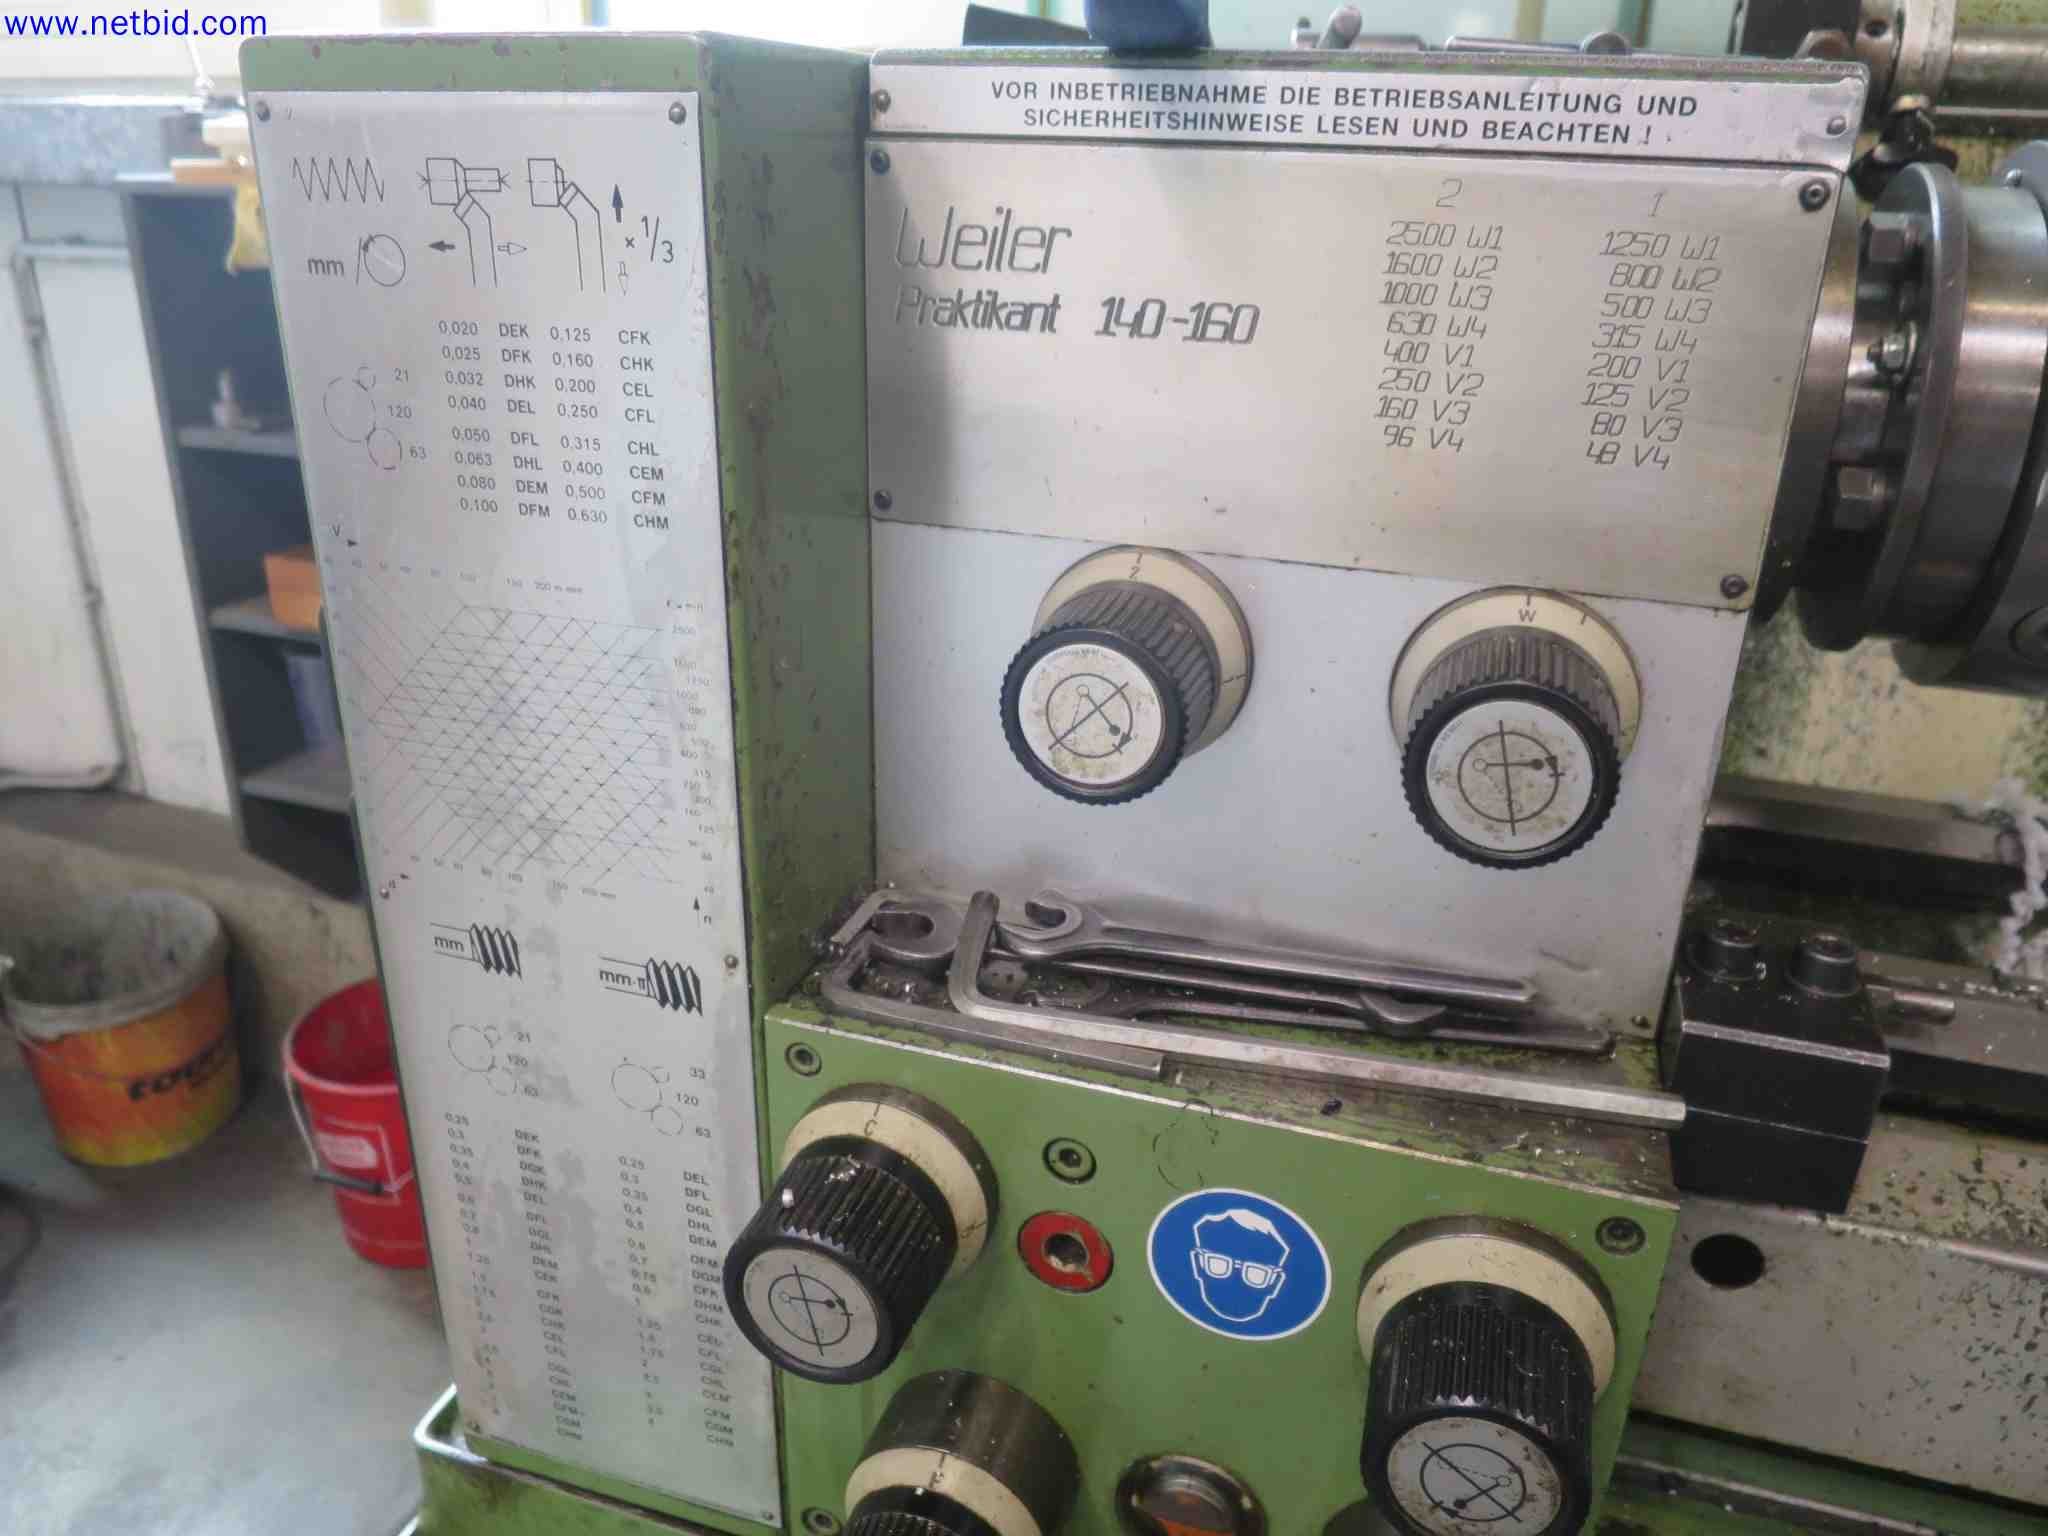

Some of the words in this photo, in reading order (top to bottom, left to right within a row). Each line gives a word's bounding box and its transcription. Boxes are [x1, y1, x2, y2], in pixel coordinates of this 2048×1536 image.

[991, 81, 1038, 99] VOR
[1050, 82, 1267, 104] INBETRIEBNAHME
[1280, 86, 1321, 105] DIE
[1334, 87, 1622, 113] BETRIEBSANLEITUNG
[1637, 95, 1698, 117] UND
[1023, 109, 1304, 133] SICHERHEITSHINWEISE
[1317, 116, 1399, 136] LESEN
[1412, 118, 1468, 138] UND
[1481, 120, 1630, 144] BEACHTEN
[1435, 178, 1464, 208] 2
[1648, 190, 1667, 218] 1
[895, 206, 1073, 274] Weiler
[1385, 221, 1457, 248] 2500
[1466, 223, 1504, 251] W1
[1599, 231, 1671, 258] 1250
[1679, 234, 1720, 261] W1
[307, 257, 345, 278] mm
[1381, 251, 1443, 277] 1600
[1453, 255, 1498, 281] W2
[1608, 262, 1664, 290] 800
[1671, 265, 1722, 292] W2
[1378, 280, 1439, 306] 1000
[1448, 281, 1493, 311] W3
[1601, 293, 1654, 319] 500
[1664, 296, 1713, 324] W3
[895, 284, 1062, 334] Praktikant
[1094, 296, 1261, 345] 140-160
[1386, 311, 1437, 336] 630
[1446, 314, 1487, 340] W4
[499, 323, 529, 338] DEK
[618, 330, 651, 345] CFK
[1592, 323, 1646, 349] 315
[1654, 327, 1699, 355] W4
[502, 349, 532, 364] DFK
[619, 355, 655, 372] CHK
[1383, 338, 1430, 364] 400
[1444, 342, 1475, 368] V1
[1378, 366, 1431, 393] 250
[1445, 370, 1485, 397] V2
[1586, 352, 1642, 379] 200
[1657, 358, 1690, 384] V1
[504, 374, 537, 390] DHK
[622, 382, 654, 398] CEL
[1580, 382, 1635, 408] 125
[1649, 384, 1690, 412] V2
[387, 404, 412, 420] 120
[507, 399, 536, 415] DEL
[624, 408, 655, 424] CFL
[1373, 395, 1418, 421] 160
[1433, 399, 1471, 425] V3
[1383, 424, 1416, 449] 96
[1429, 426, 1465, 453] V4
[1590, 411, 1627, 437] 80
[1642, 414, 1684, 442] V3
[408, 444, 427, 460] 63
[510, 431, 539, 447] DFL
[627, 440, 660, 457] CHL
[1586, 440, 1621, 465] 48
[1634, 443, 1671, 471] V4
[513, 455, 544, 471] DHL
[629, 466, 664, 481] CEM
[515, 479, 549, 495] DEM
[631, 490, 666, 507] CFM
[518, 502, 551, 519] DFM
[633, 514, 670, 531] CHM
[1518, 608, 1537, 623] W
[434, 935, 465, 953] mm
[676, 1092, 700, 1107] 120
[863, 1119, 879, 1137] C
[683, 1170, 711, 1186] DEL
[684, 1187, 712, 1202] DFL
[688, 1234, 718, 1249] DEM
